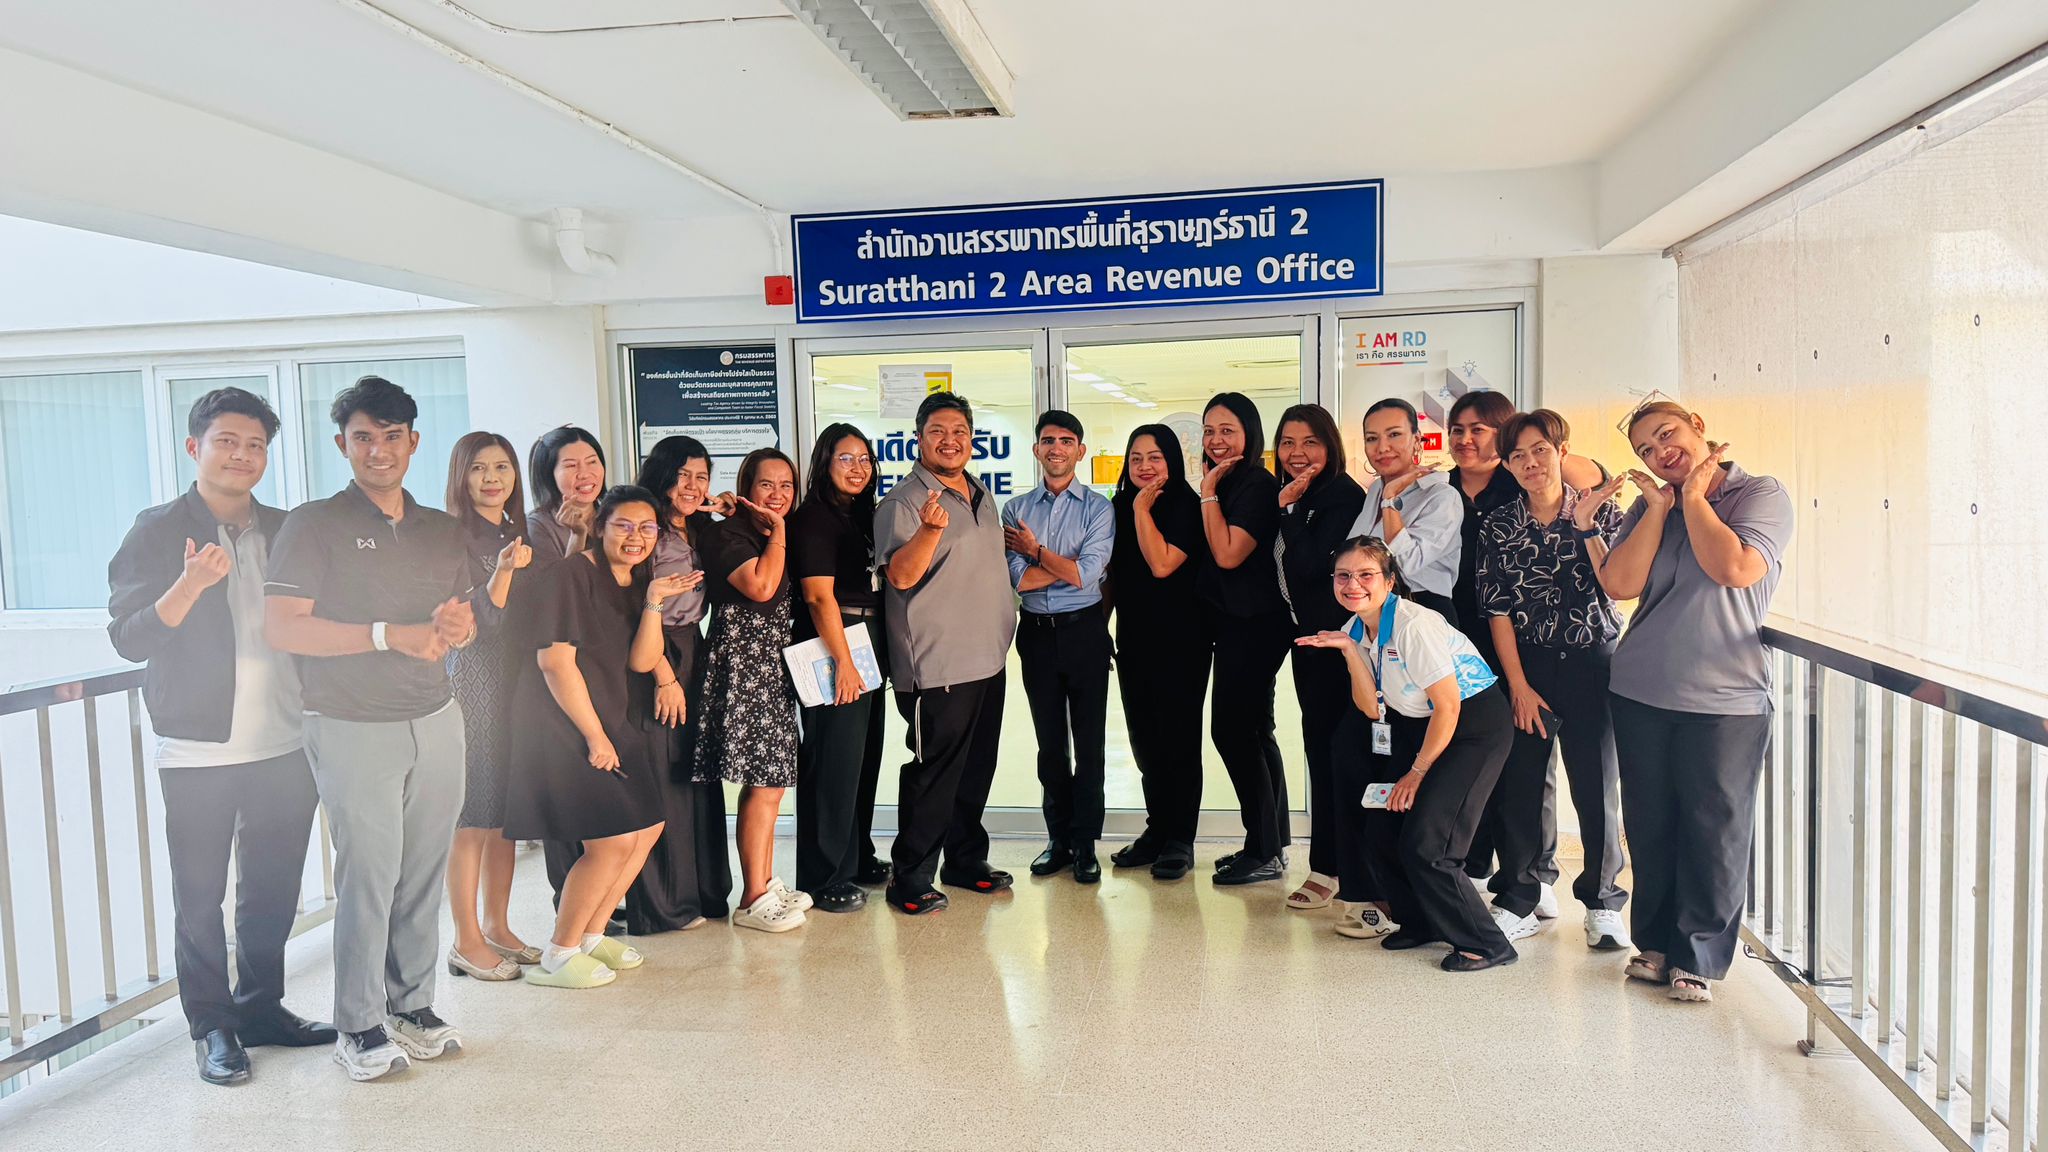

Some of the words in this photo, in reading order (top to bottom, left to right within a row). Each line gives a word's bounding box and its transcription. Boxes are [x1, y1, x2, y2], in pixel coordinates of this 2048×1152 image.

[857, 205, 1276, 260] สำนักงานสรรพากรพื้นที่สุราษฎร์ธานี
[1290, 207, 1309, 236] 2
[818, 272, 976, 306] Suratthani
[989, 271, 1007, 298] 2
[1020, 270, 1093, 297] Area
[1106, 264, 1243, 292] Revenue
[1256, 252, 1355, 284] Office
[1355, 333, 1367, 348] I
[1372, 332, 1398, 348] AM
[1402, 331, 1427, 347] RD
[1356, 352, 1369, 360] เรา
[1387, 350, 1426, 359] สรรพากร
